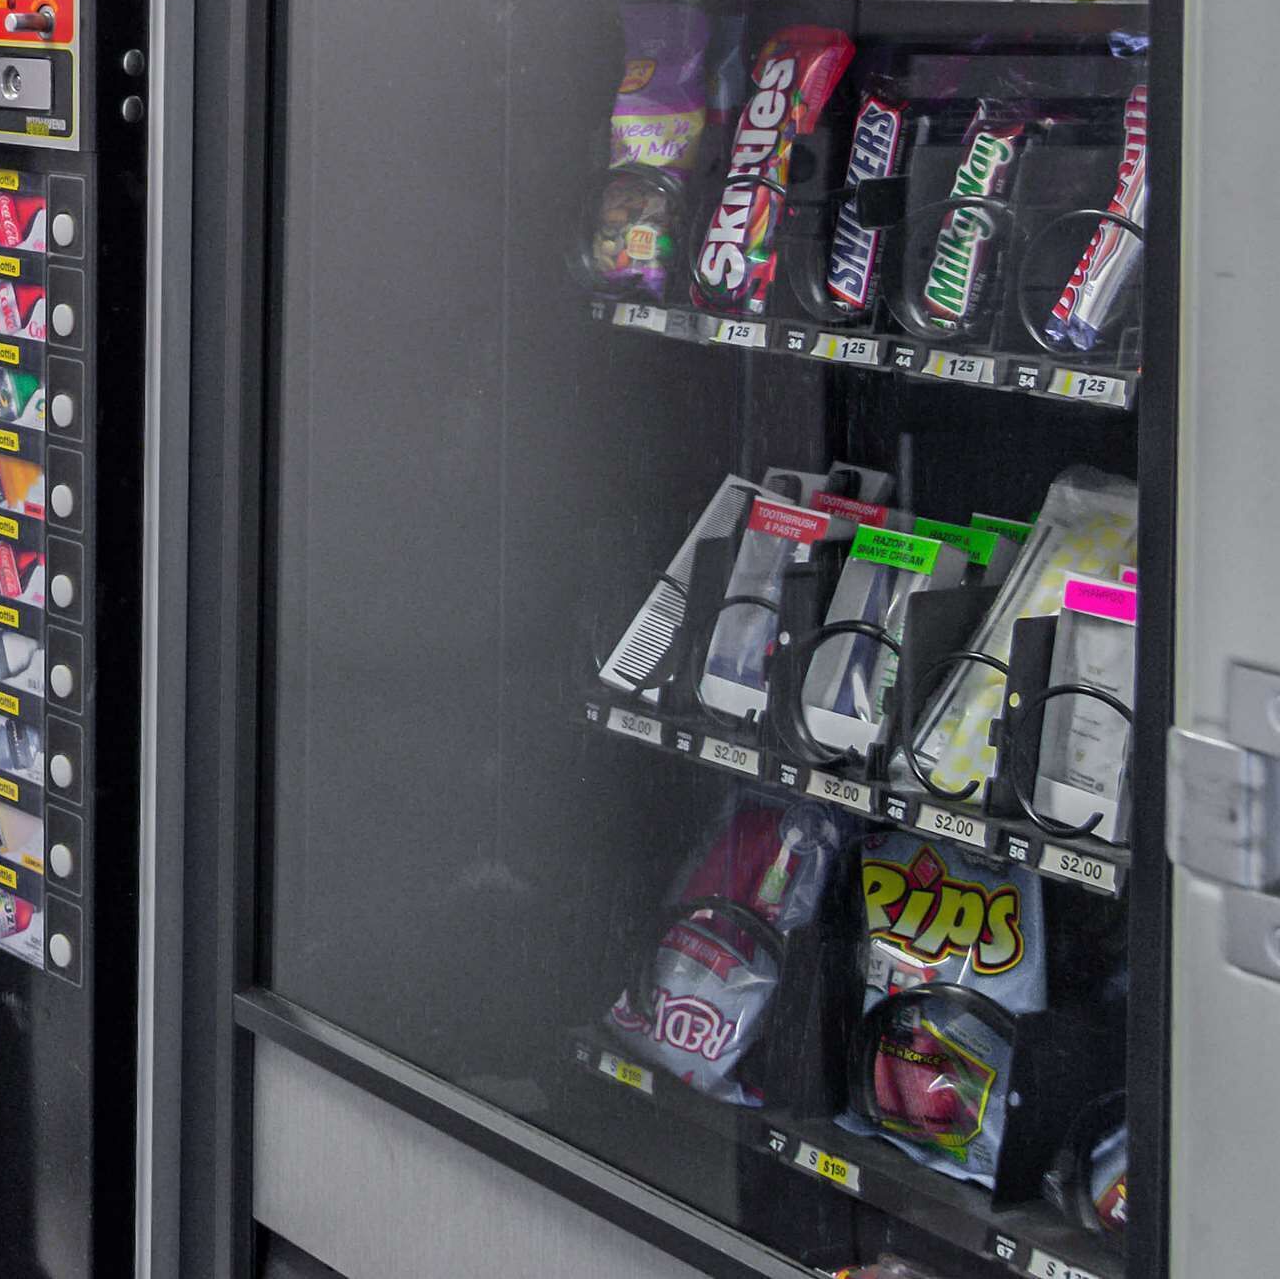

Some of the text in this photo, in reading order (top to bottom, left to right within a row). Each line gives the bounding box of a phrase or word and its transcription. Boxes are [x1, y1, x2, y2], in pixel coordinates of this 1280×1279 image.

[727, 325, 751, 341] 125
[788, 338, 802, 350] 34
[841, 342, 866, 358] 125
[895, 355, 912, 368] 44
[949, 359, 976, 376] 125
[1018, 374, 1035, 388] 54
[1077, 378, 1107, 395] 125
[758, 506, 818, 531] TOOTHBRUSH
[764, 521, 802, 538] & PASTE
[873, 534, 914, 553] RAZOR &
[856, 544, 925, 567] SHAVE CREAM
[621, 716, 651, 736] $2.00
[714, 744, 747, 766] $2.00
[780, 772, 795, 786] 36
[824, 779, 860, 802] $2.00
[887, 806, 904, 820] 46
[934, 813, 974, 838] $2.00
[1008, 845, 1027, 861] 56
[1059, 854, 1103, 880] $2.00
[862, 846, 1023, 972] Rips
[768, 1138, 785, 1152] 47
[996, 1243, 1015, 1261] 67
